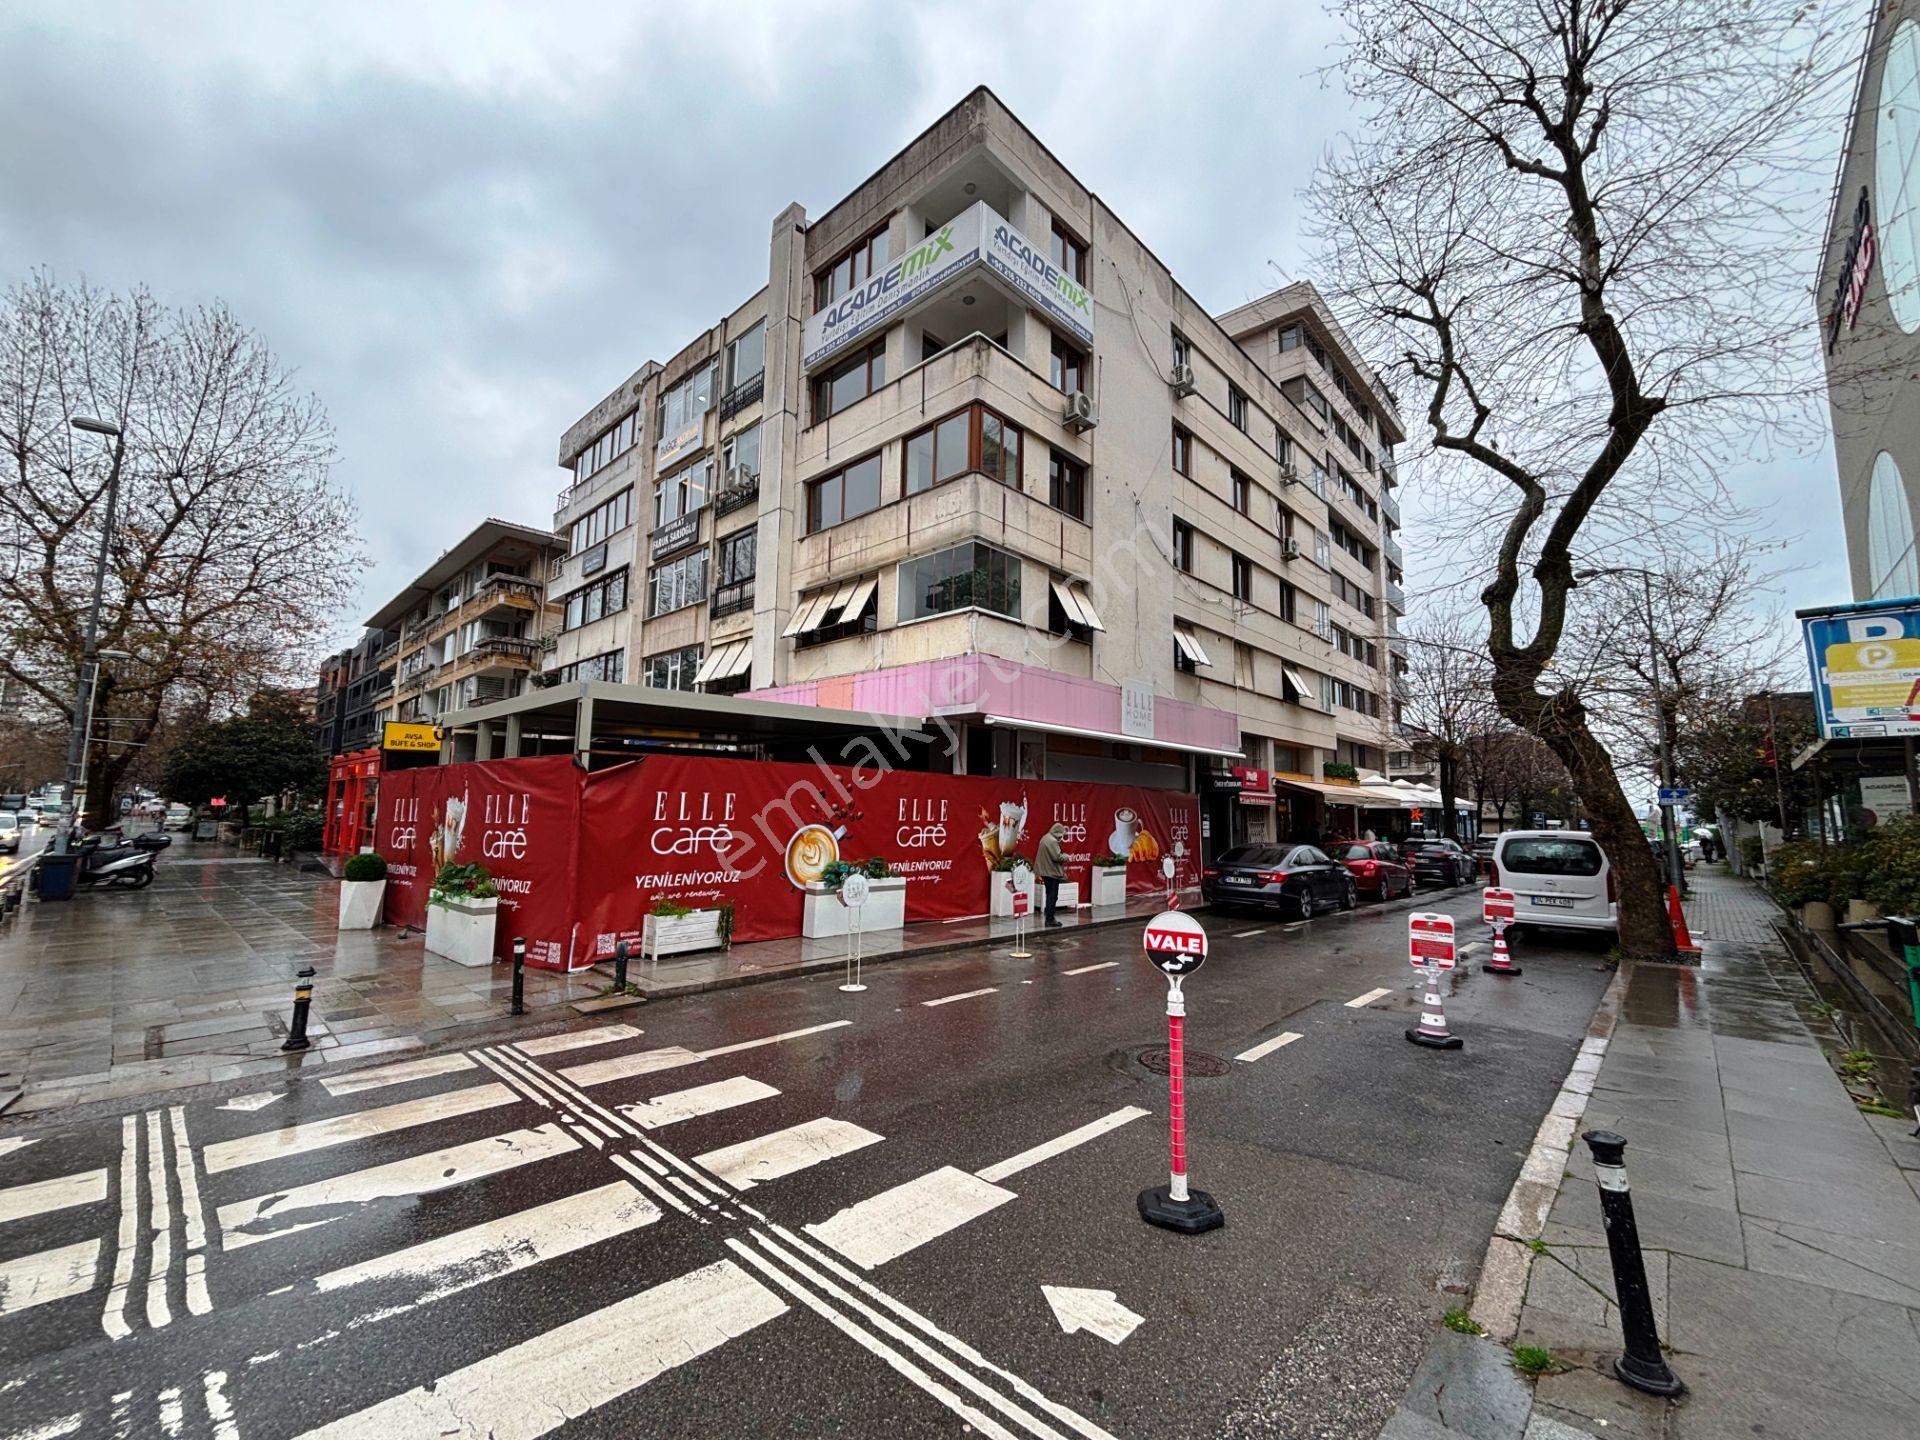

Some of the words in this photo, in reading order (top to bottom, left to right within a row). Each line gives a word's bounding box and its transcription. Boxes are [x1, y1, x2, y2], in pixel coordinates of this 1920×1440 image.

[393, 798, 420, 822] ELLE
[485, 794, 530, 824] ELLE
[653, 791, 736, 821] ELLE
[898, 798, 948, 822] ELLE
[1053, 803, 1086, 822] ELLE
[888, 859, 952, 873] YENİLENİYORUZ
[635, 870, 741, 889] YENİLENİYORUZ
[1147, 933, 1201, 954] VALE
